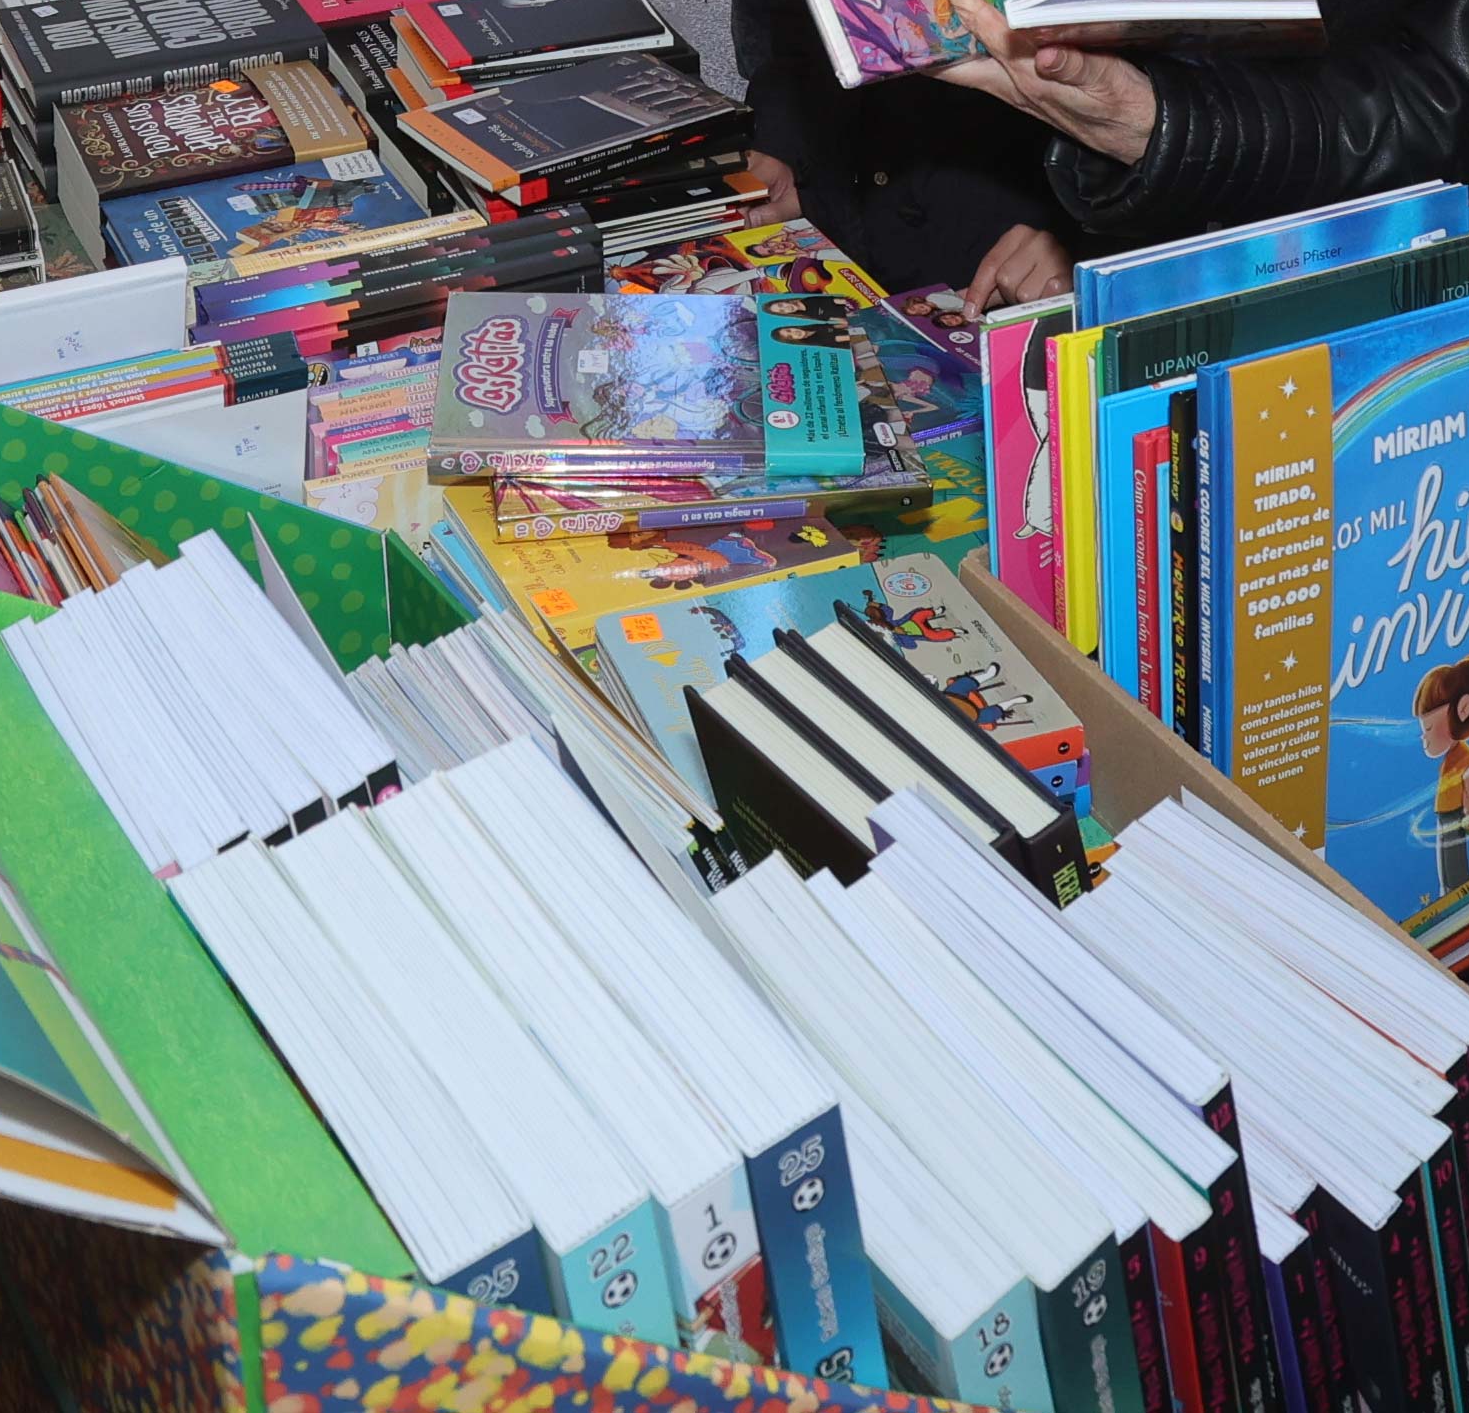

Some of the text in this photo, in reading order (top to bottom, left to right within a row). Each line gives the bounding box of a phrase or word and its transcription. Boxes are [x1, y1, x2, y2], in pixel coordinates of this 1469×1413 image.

[41, 19, 100, 51] DON
[163, 94, 231, 153] HOMBRES
[210, 107, 230, 129] DEL
[215, 94, 270, 128] REY
[105, 113, 134, 161] LAURA GALLEGO
[125, 101, 180, 159] TODOS LOS
[488, 123, 539, 158] Stefan Zweig
[1254, 245, 1343, 276] Marcus Pfister
[1145, 350, 1209, 380] LUPANO
[1373, 412, 1468, 465] MÍRIAM
[1170, 431, 1183, 501] Emberley
[1254, 457, 1315, 486] MÍRIAM
[724, 509, 751, 518] magia
[753, 509, 764, 517] La
[1253, 484, 1317, 514] TIRADO,
[704, 511, 722, 521] está
[1240, 507, 1330, 543] la autora de
[1332, 500, 1407, 553] OS MIL
[1244, 533, 1325, 567] referencia
[1238, 557, 1330, 598] para más de
[1172, 552, 1186, 649] MONSTRUO
[1247, 584, 1321, 616] 500.000
[1253, 610, 1315, 641] familias
[1243, 683, 1323, 717] Hay tantos hilos
[1241, 703, 1325, 732] como relaciones.
[1243, 715, 1322, 747] Un cuento para
[1241, 744, 1322, 777] los vínculos que
[1243, 745, 1276, 763] valorar
[1286, 729, 1322, 750] cuidar
[1258, 764, 1304, 788] nos unen
[777, 1134, 825, 1187] 25
[1435, 1159, 1454, 1188] 10
[703, 1203, 721, 1233] 1
[586, 1232, 636, 1280] 22
[977, 1312, 1011, 1350] 18
